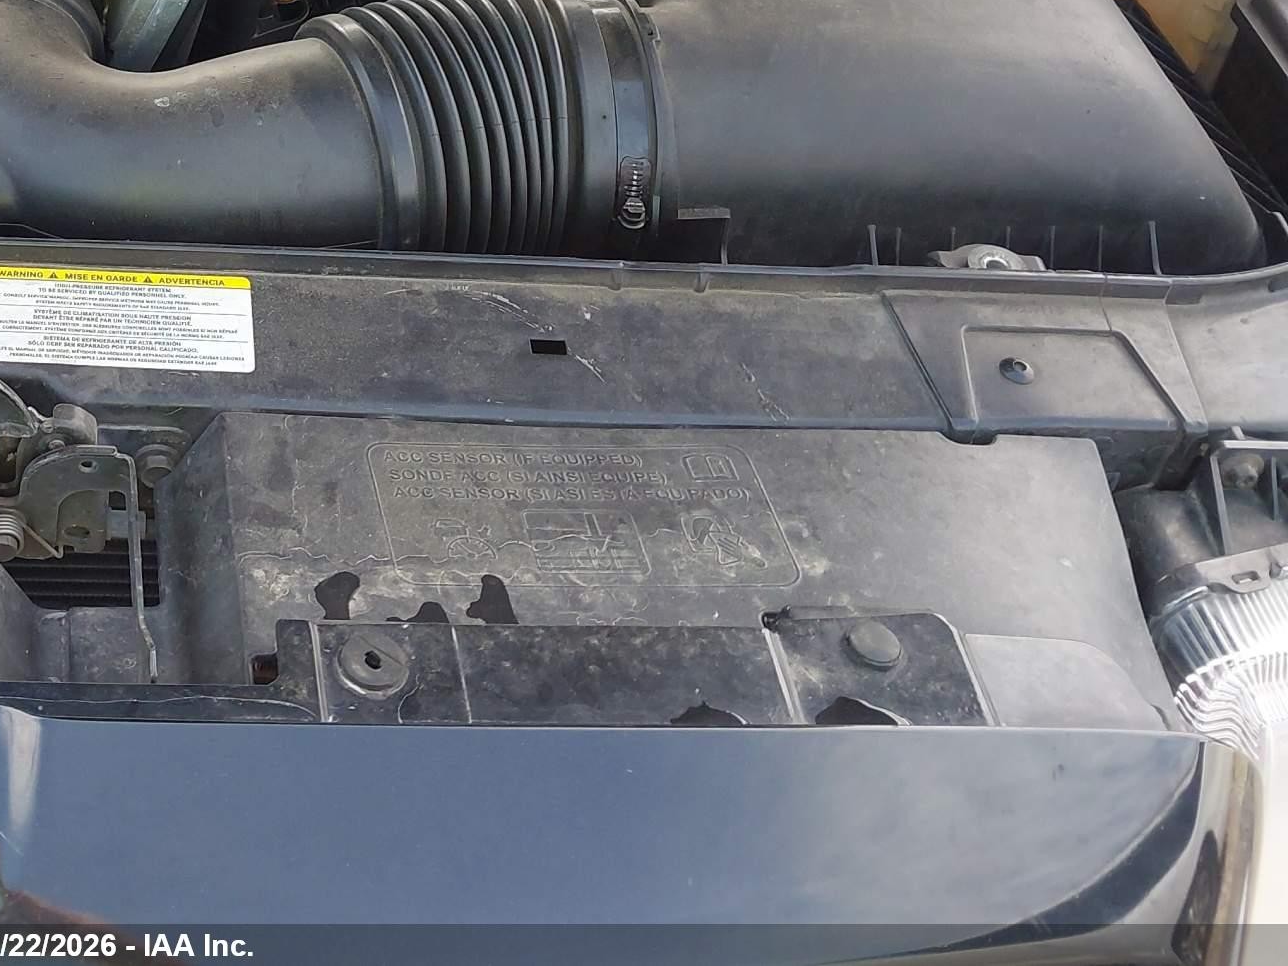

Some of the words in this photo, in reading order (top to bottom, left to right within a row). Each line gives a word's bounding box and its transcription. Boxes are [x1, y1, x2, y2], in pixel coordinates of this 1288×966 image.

[106, 274, 138, 282] GARDE
[159, 276, 225, 285] ADVERTENCIA
[384, 450, 422, 462] ACC
[428, 451, 506, 464] SENSOR
[461, 470, 501, 482] ACC
[394, 487, 434, 499] ACC
[439, 487, 520, 500] SENSOR
